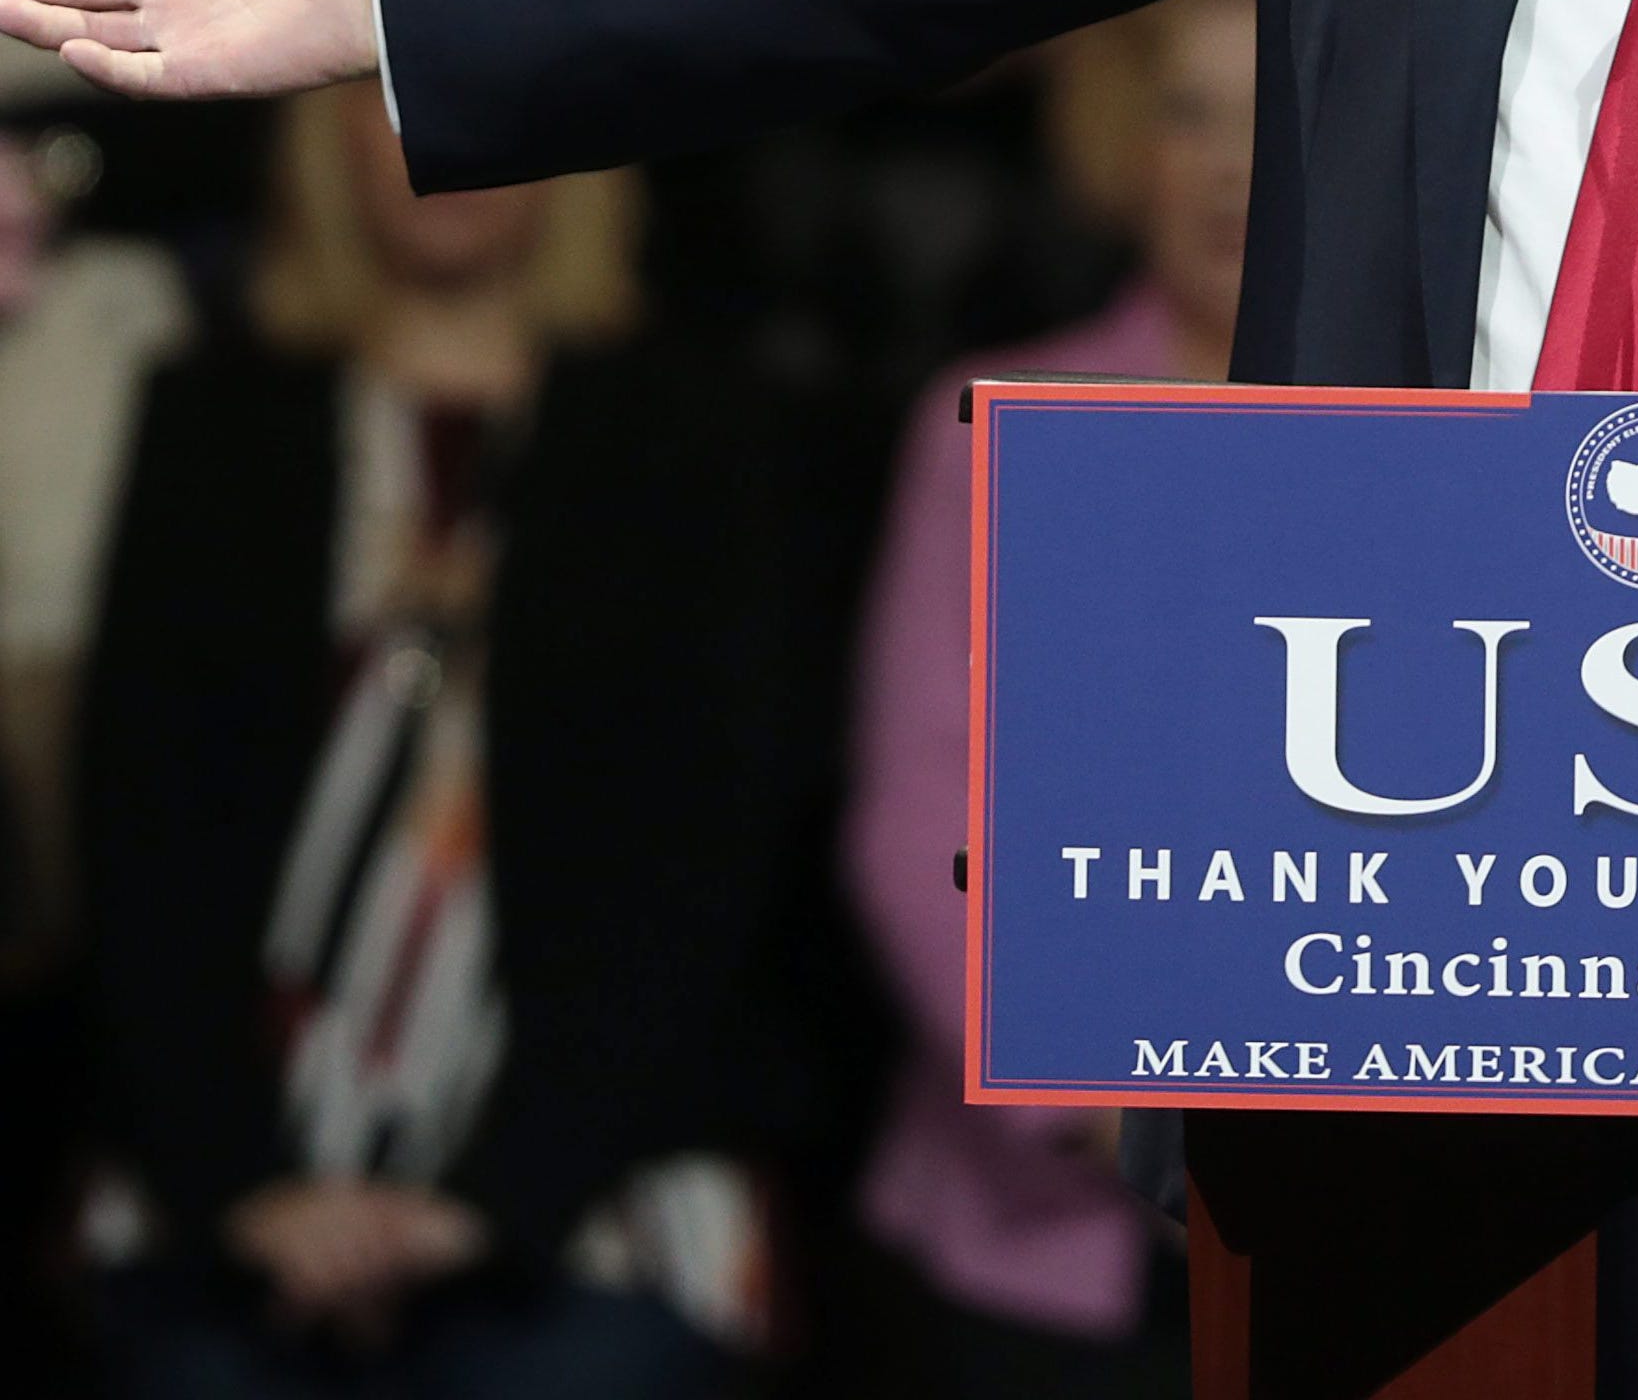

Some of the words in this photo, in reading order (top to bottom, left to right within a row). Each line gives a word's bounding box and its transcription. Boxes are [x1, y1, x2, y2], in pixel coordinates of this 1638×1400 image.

[1586, 436, 1623, 500] PRESIDENT
[1061, 847, 1389, 904] THANK
[1455, 854, 1638, 909] YOU
[1131, 1039, 1331, 1079] MAKE
